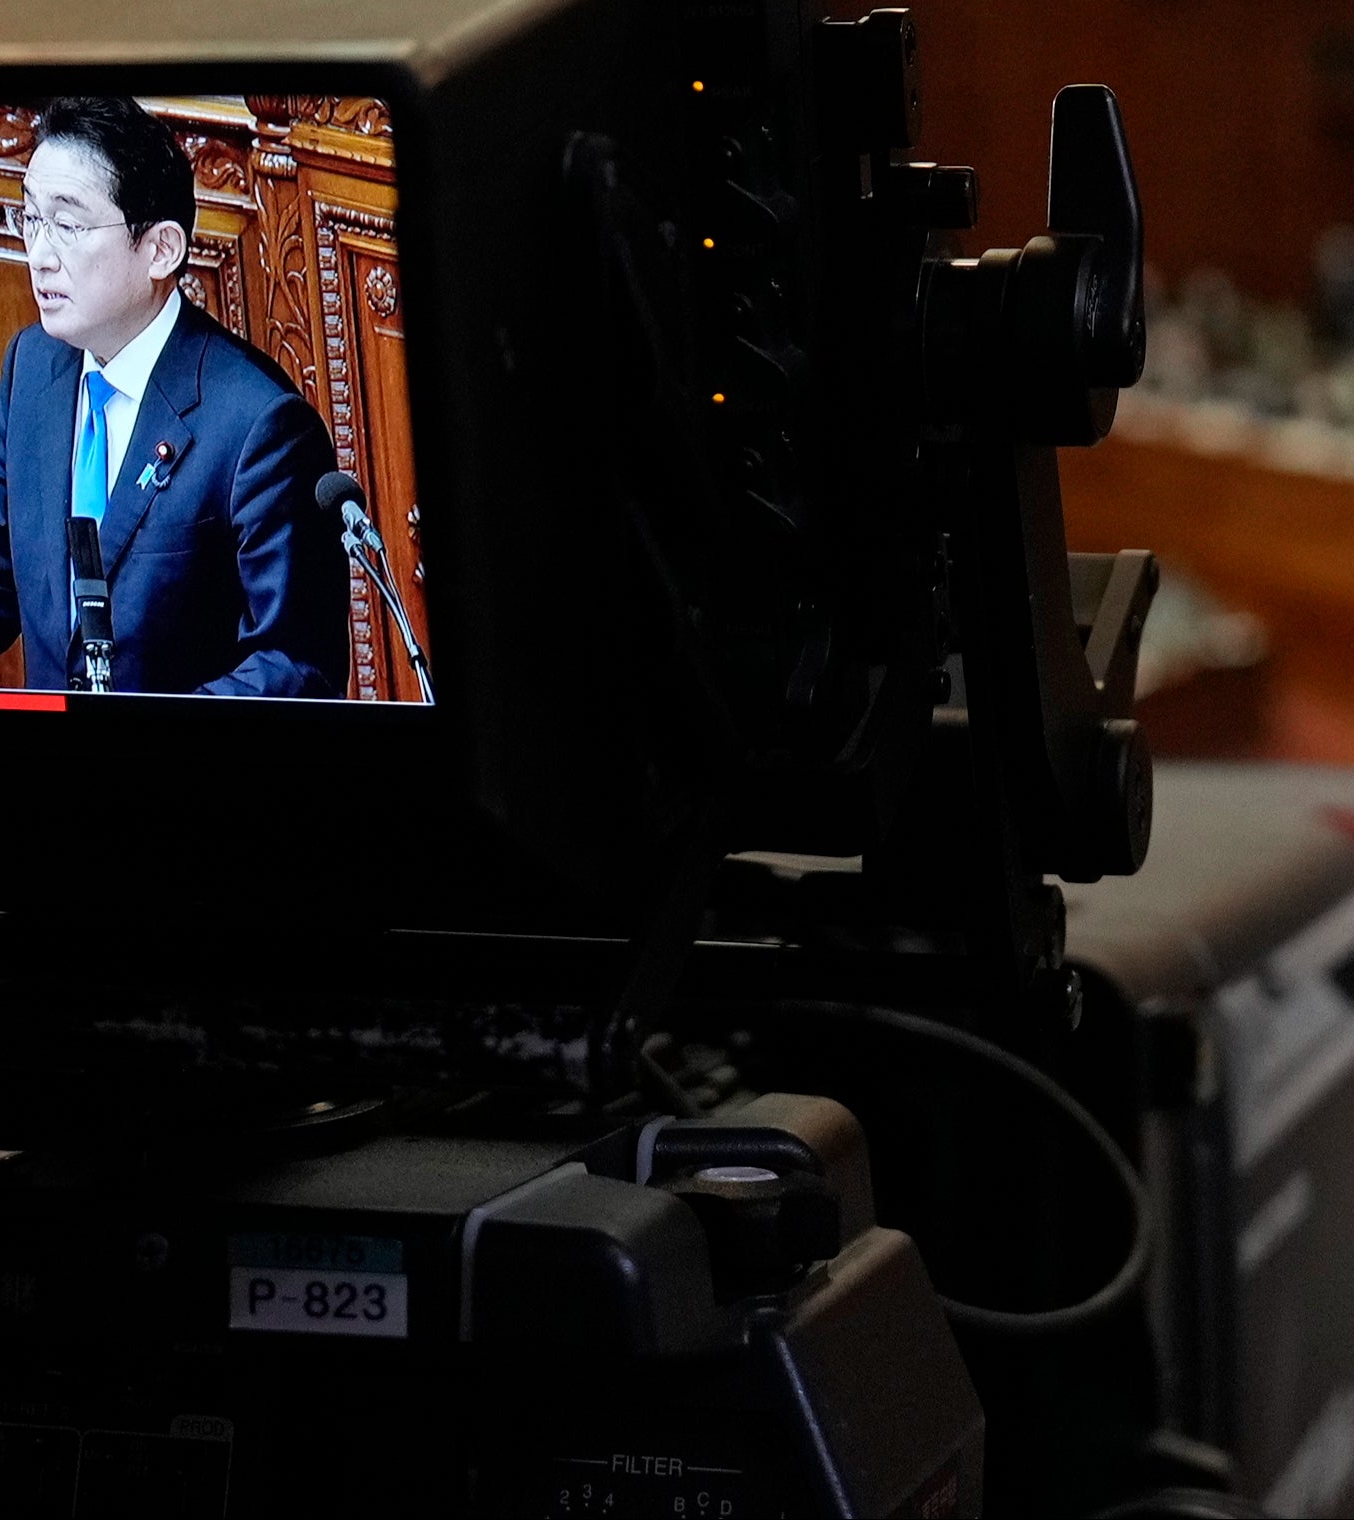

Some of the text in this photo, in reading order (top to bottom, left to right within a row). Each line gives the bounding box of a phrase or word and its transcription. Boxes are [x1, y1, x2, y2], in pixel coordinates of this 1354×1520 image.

[248, 1277, 388, 1322] P-823
[180, 1419, 226, 1437] PROD
[611, 1453, 683, 1477] FILTER
[559, 1483, 615, 1508] 2 3 4
[673, 1491, 734, 1516] B C D
